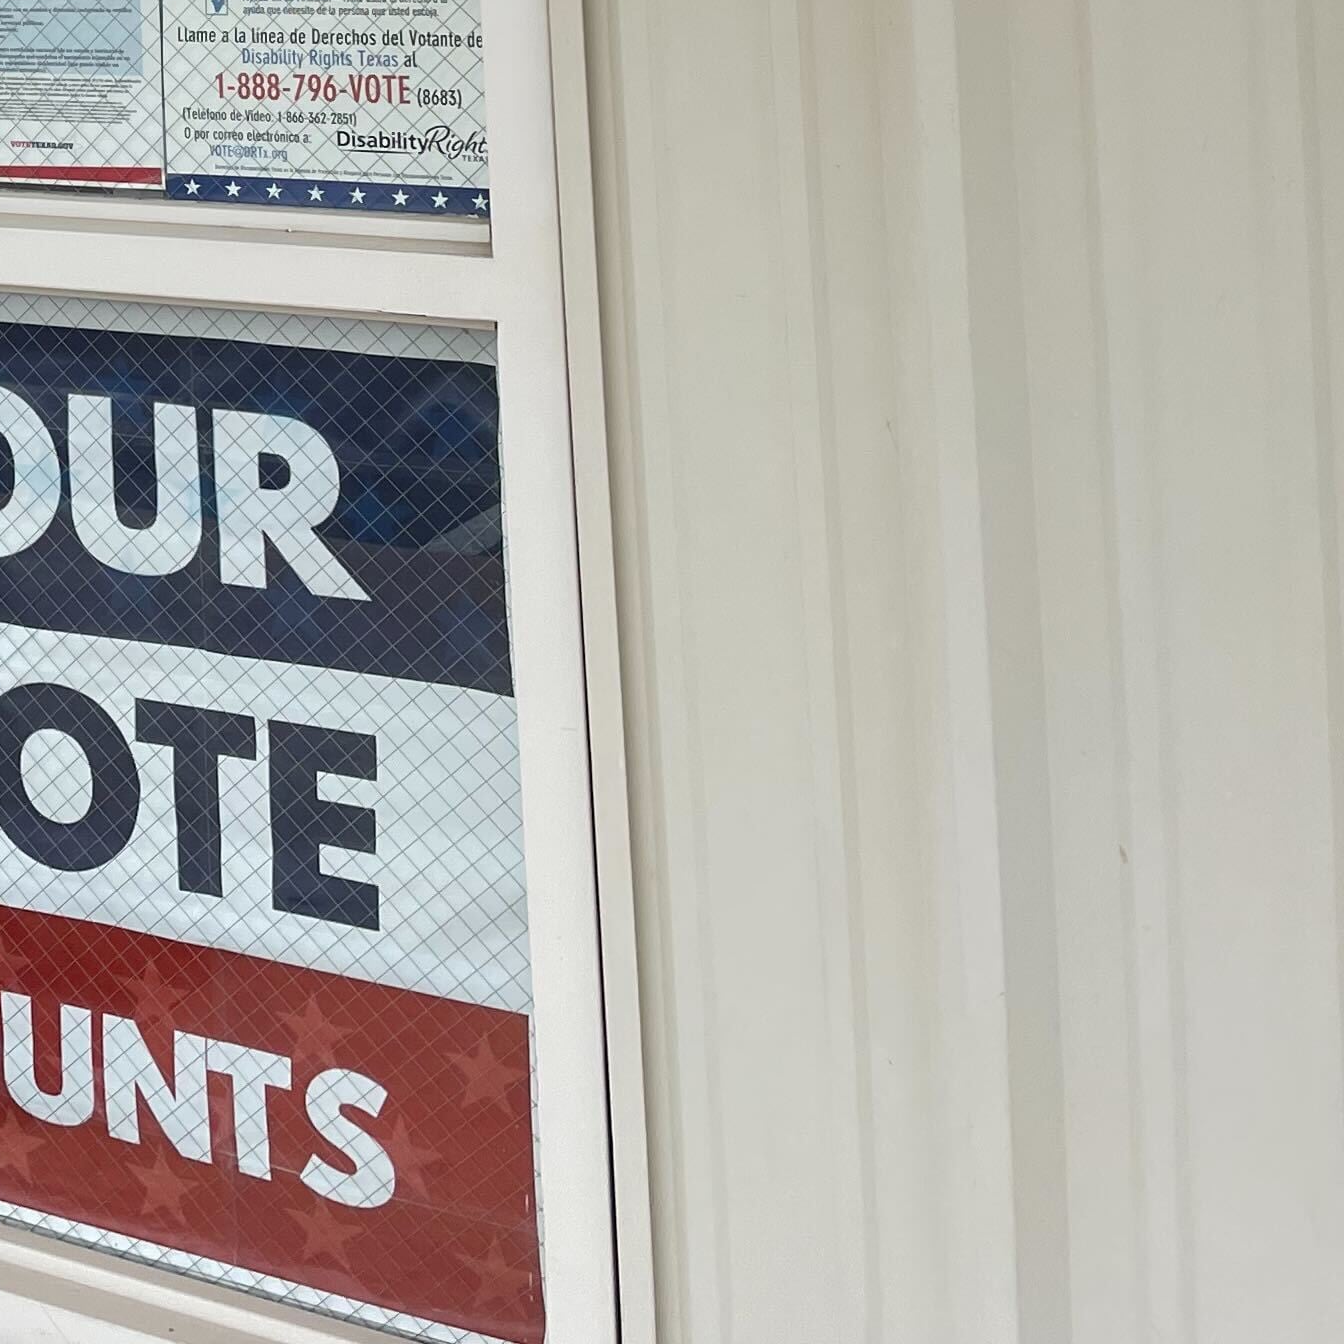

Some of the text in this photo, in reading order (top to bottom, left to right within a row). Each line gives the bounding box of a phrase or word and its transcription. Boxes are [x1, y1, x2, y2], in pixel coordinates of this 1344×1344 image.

[177, 27, 216, 43] Llame
[221, 30, 229, 43] a
[234, 28, 246, 43] la
[291, 28, 306, 45] de
[311, 29, 376, 46] Derechos
[382, 29, 404, 47] del
[409, 30, 462, 47] Votante
[467, 31, 483, 48] de
[242, 48, 418, 69] Disability Rights Texas al
[215, 72, 462, 109] 1-888-796-VOTE (8683)
[231, 109, 242, 120] de
[278, 111, 357, 127] 1-866-362-2851)
[184, 127, 191, 139] O
[194, 130, 209, 141] por
[213, 130, 243, 140] correo
[247, 130, 299, 143] electrónico
